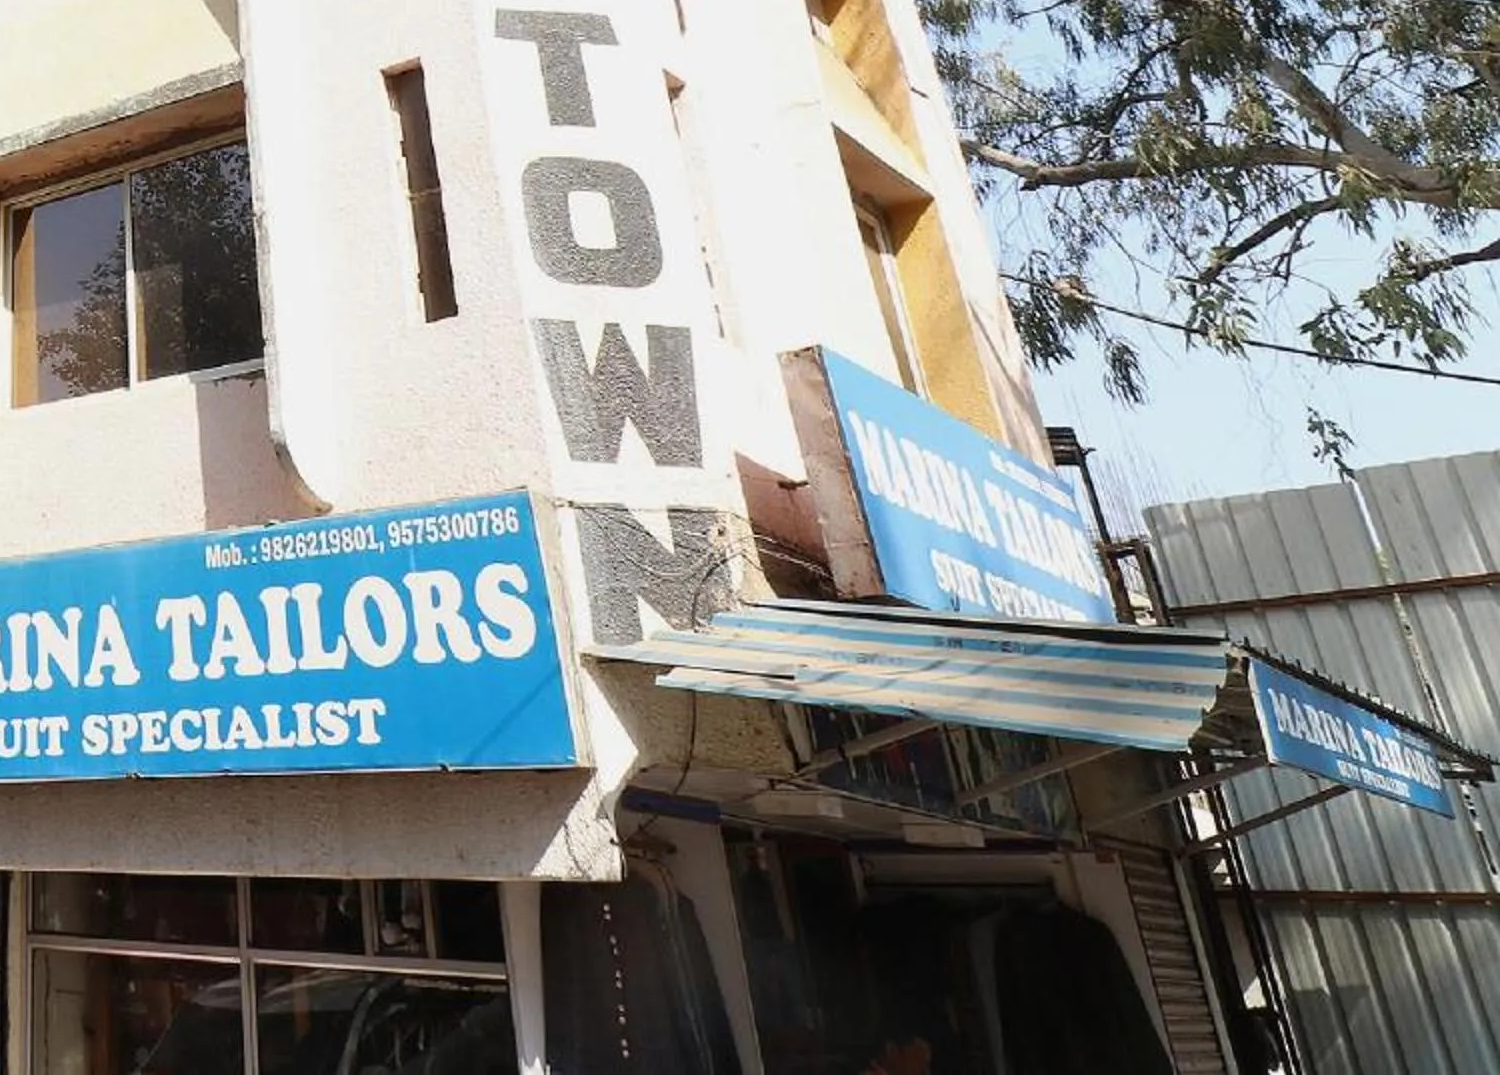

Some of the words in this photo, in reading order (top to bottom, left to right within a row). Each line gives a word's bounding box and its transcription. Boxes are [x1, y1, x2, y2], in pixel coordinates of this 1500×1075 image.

[387, 507, 520, 548] 9575300786
[847, 409, 998, 549] MARINA
[983, 478, 1105, 598] TAILORS
[155, 562, 537, 683] TAILORS
[82, 698, 386, 757] SPECIALIST
[1266, 687, 1368, 763] MARINA
[1361, 726, 1443, 791] TAILORS
